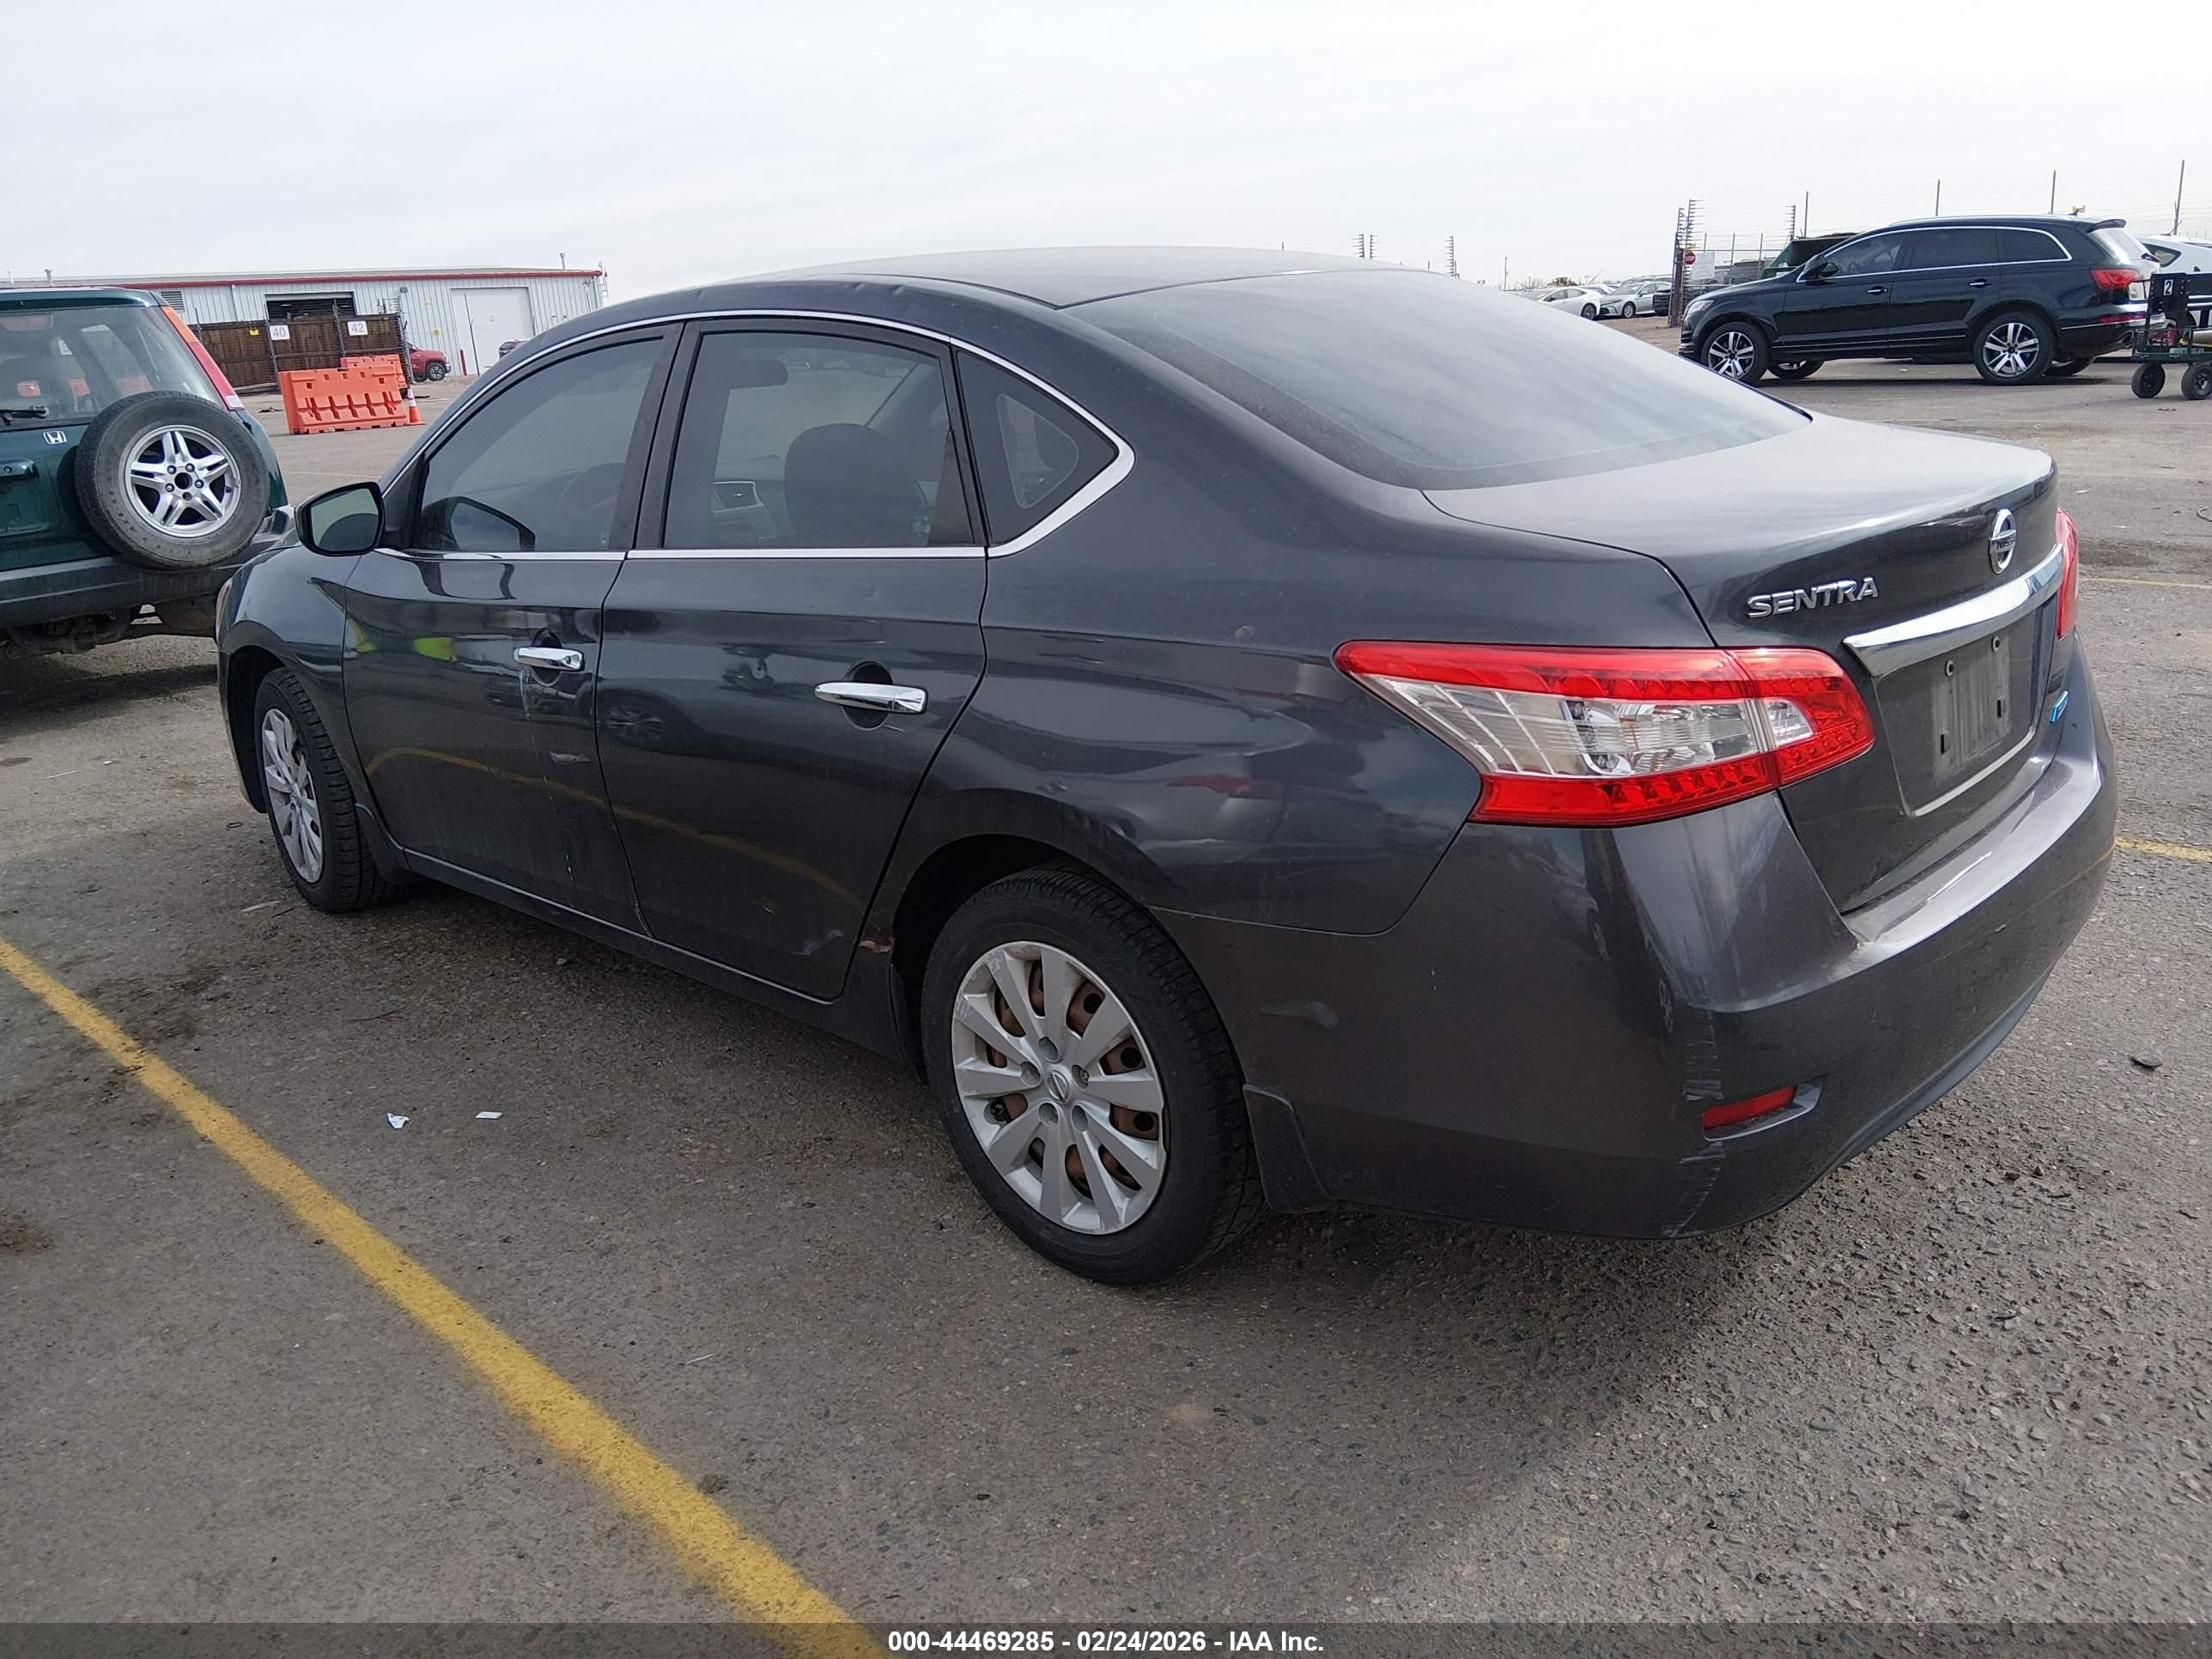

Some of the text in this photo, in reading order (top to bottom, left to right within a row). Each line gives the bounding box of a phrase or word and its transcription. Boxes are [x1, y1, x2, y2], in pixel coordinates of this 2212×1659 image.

[2165, 280, 2172, 295] 2
[274, 326, 286, 337] 40
[351, 322, 365, 333] 42
[1747, 576, 1879, 619] SENTRA
